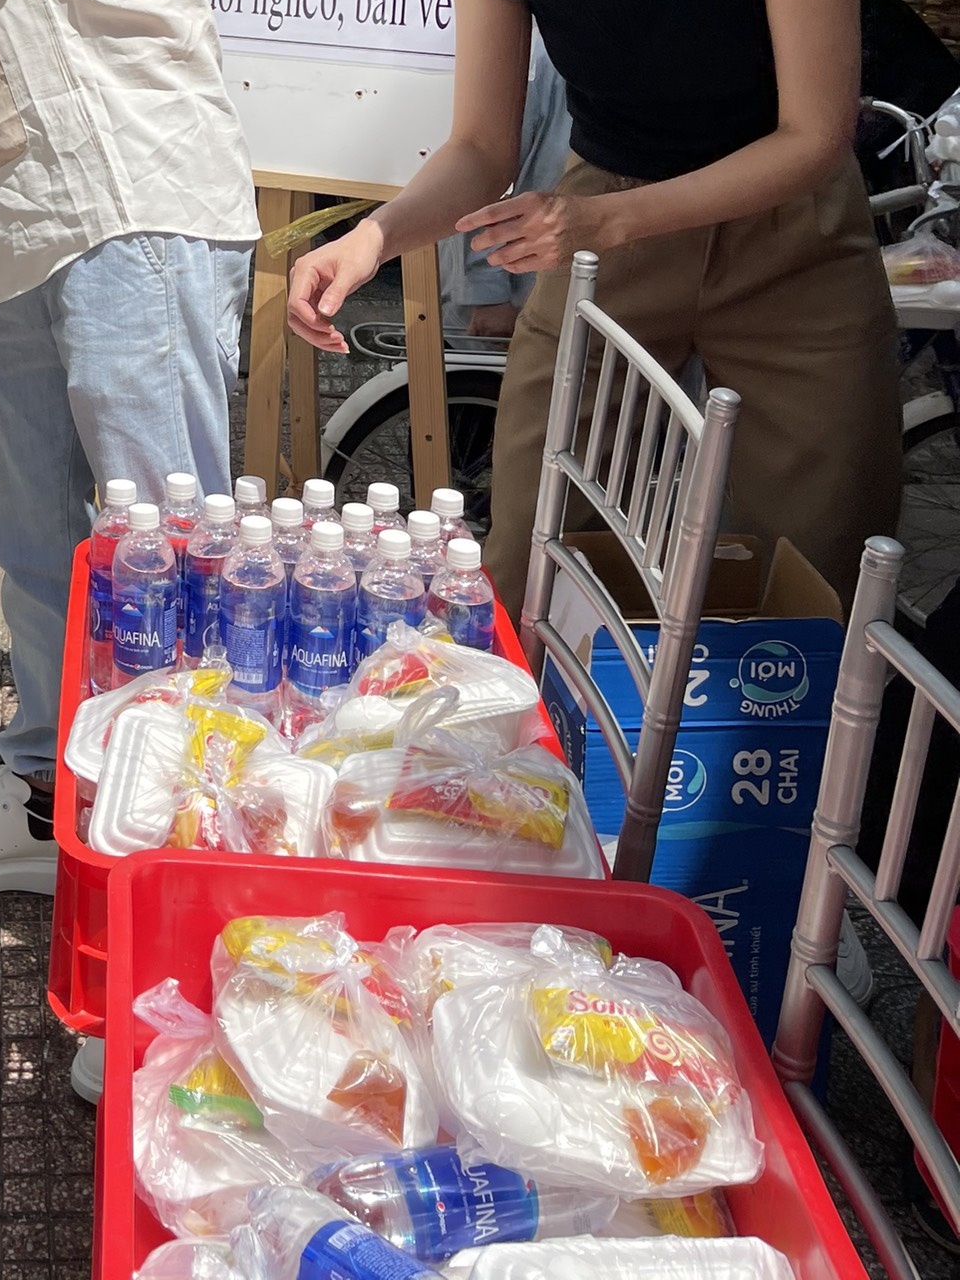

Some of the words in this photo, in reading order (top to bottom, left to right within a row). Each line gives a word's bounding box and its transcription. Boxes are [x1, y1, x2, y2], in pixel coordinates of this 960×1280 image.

[291, 644, 348, 668] AQUAFINA
[750, 659, 797, 682] MỚI
[731, 748, 771, 807] 28
[778, 748, 801, 805] CHAI
